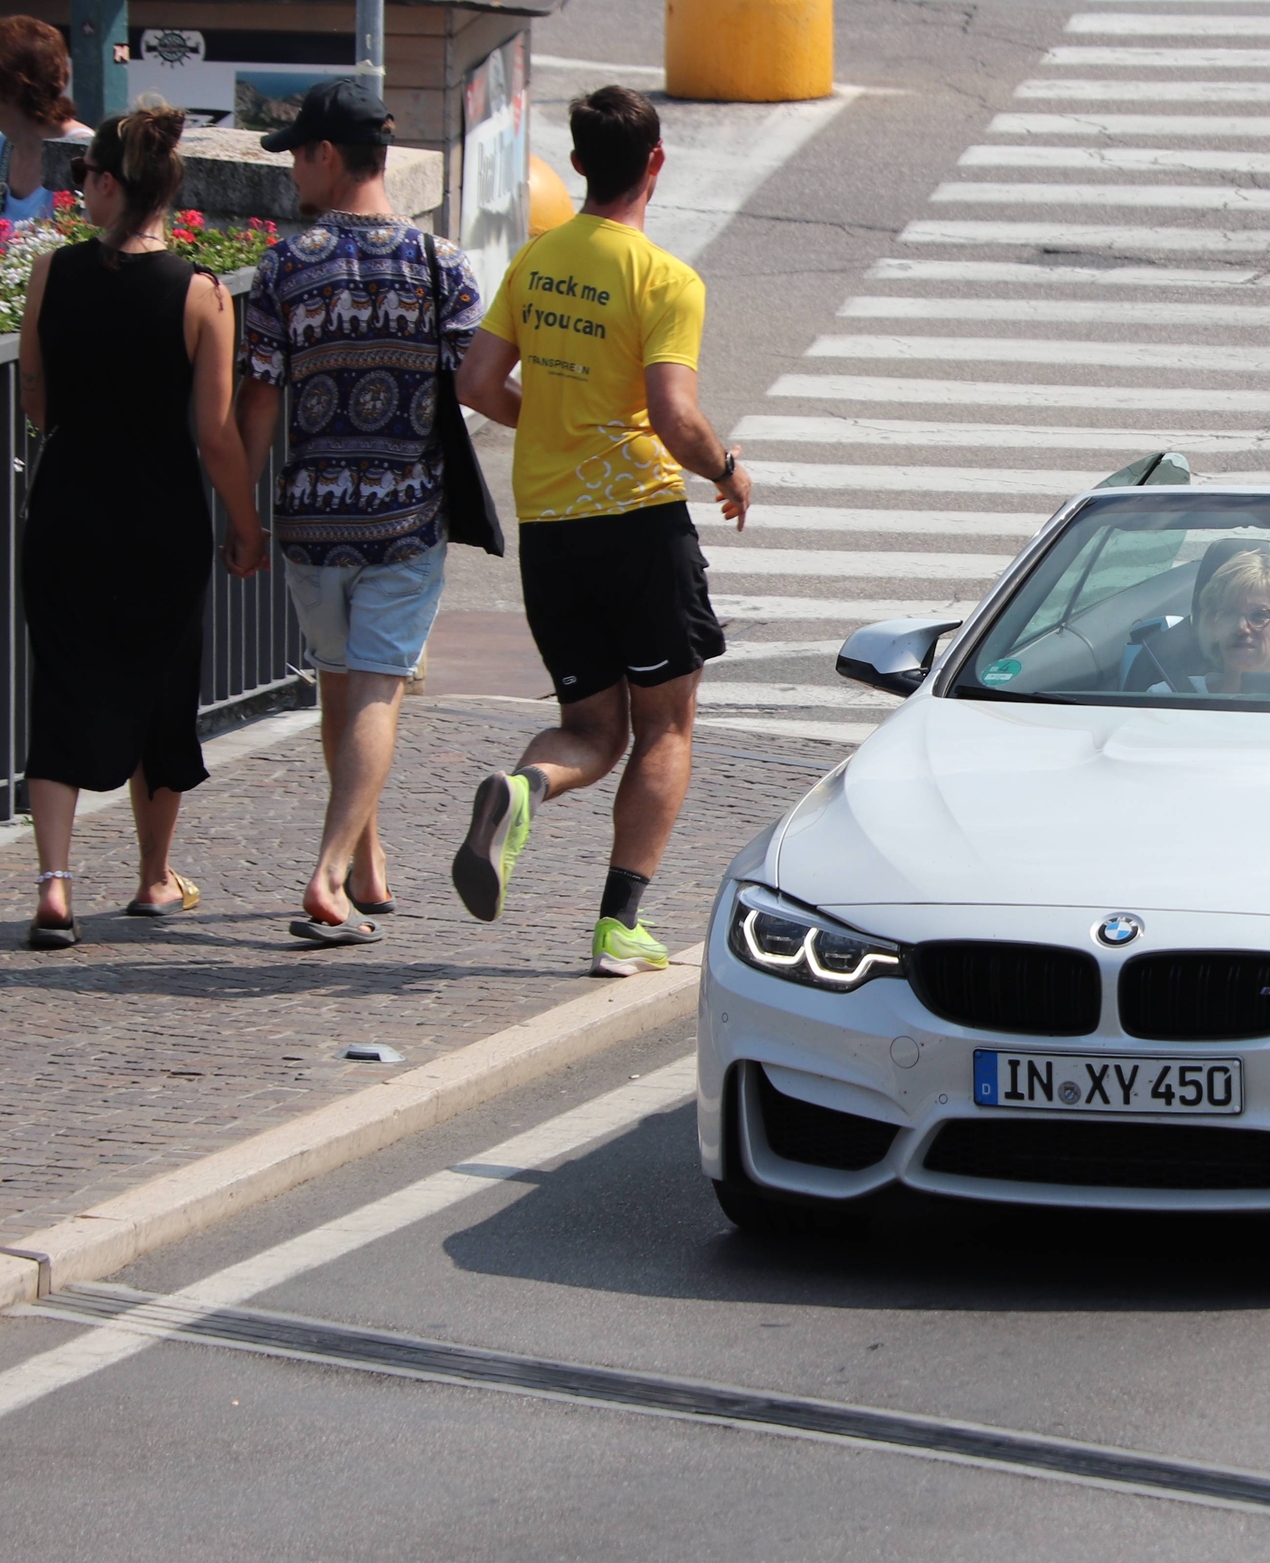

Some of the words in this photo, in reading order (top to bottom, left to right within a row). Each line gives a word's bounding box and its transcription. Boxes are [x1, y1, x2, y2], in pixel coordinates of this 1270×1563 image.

[528, 271, 579, 298] Track
[581, 284, 610, 306] me
[521, 302, 534, 325] if
[534, 308, 572, 331] you
[573, 316, 607, 340] can
[982, 1083, 991, 1095] D
[1004, 1058, 1054, 1103] IN
[1084, 1063, 1140, 1106] XY
[1150, 1065, 1233, 1107] 450
